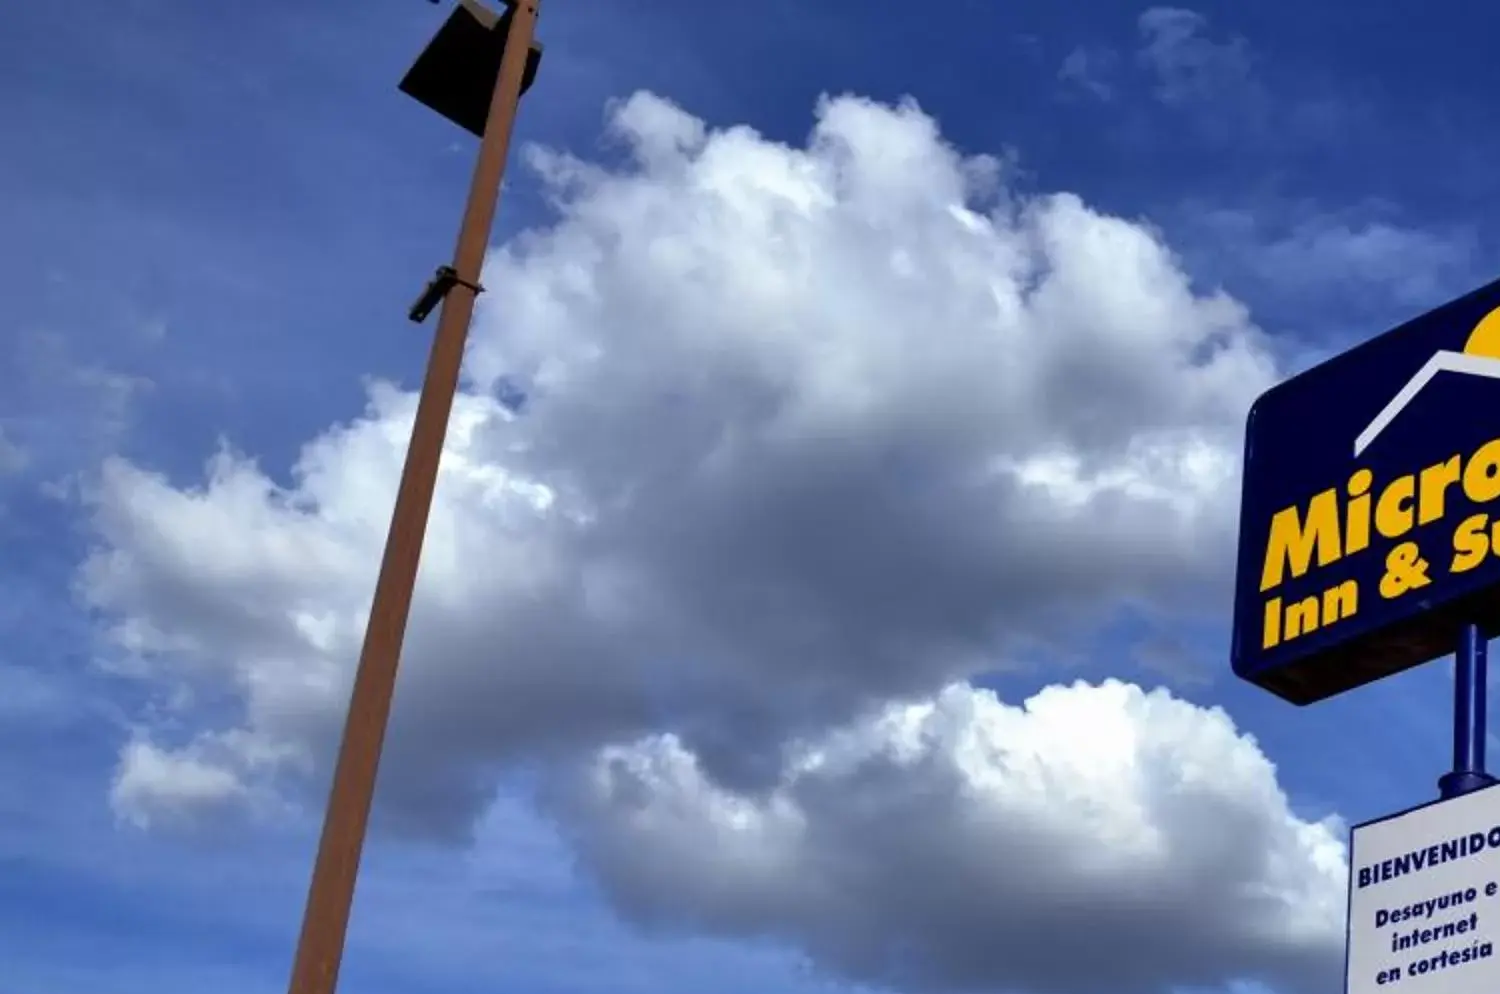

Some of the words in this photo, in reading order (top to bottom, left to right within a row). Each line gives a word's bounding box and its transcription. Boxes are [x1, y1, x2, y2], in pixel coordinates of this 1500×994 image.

[1262, 579, 1359, 649] Inn
[1379, 541, 1432, 599] &
[1375, 886, 1477, 928] Desayuno
[1485, 881, 1498, 896] e
[1391, 913, 1478, 952] internet
[1376, 966, 1401, 985] en
[1408, 939, 1493, 977] cortesía
